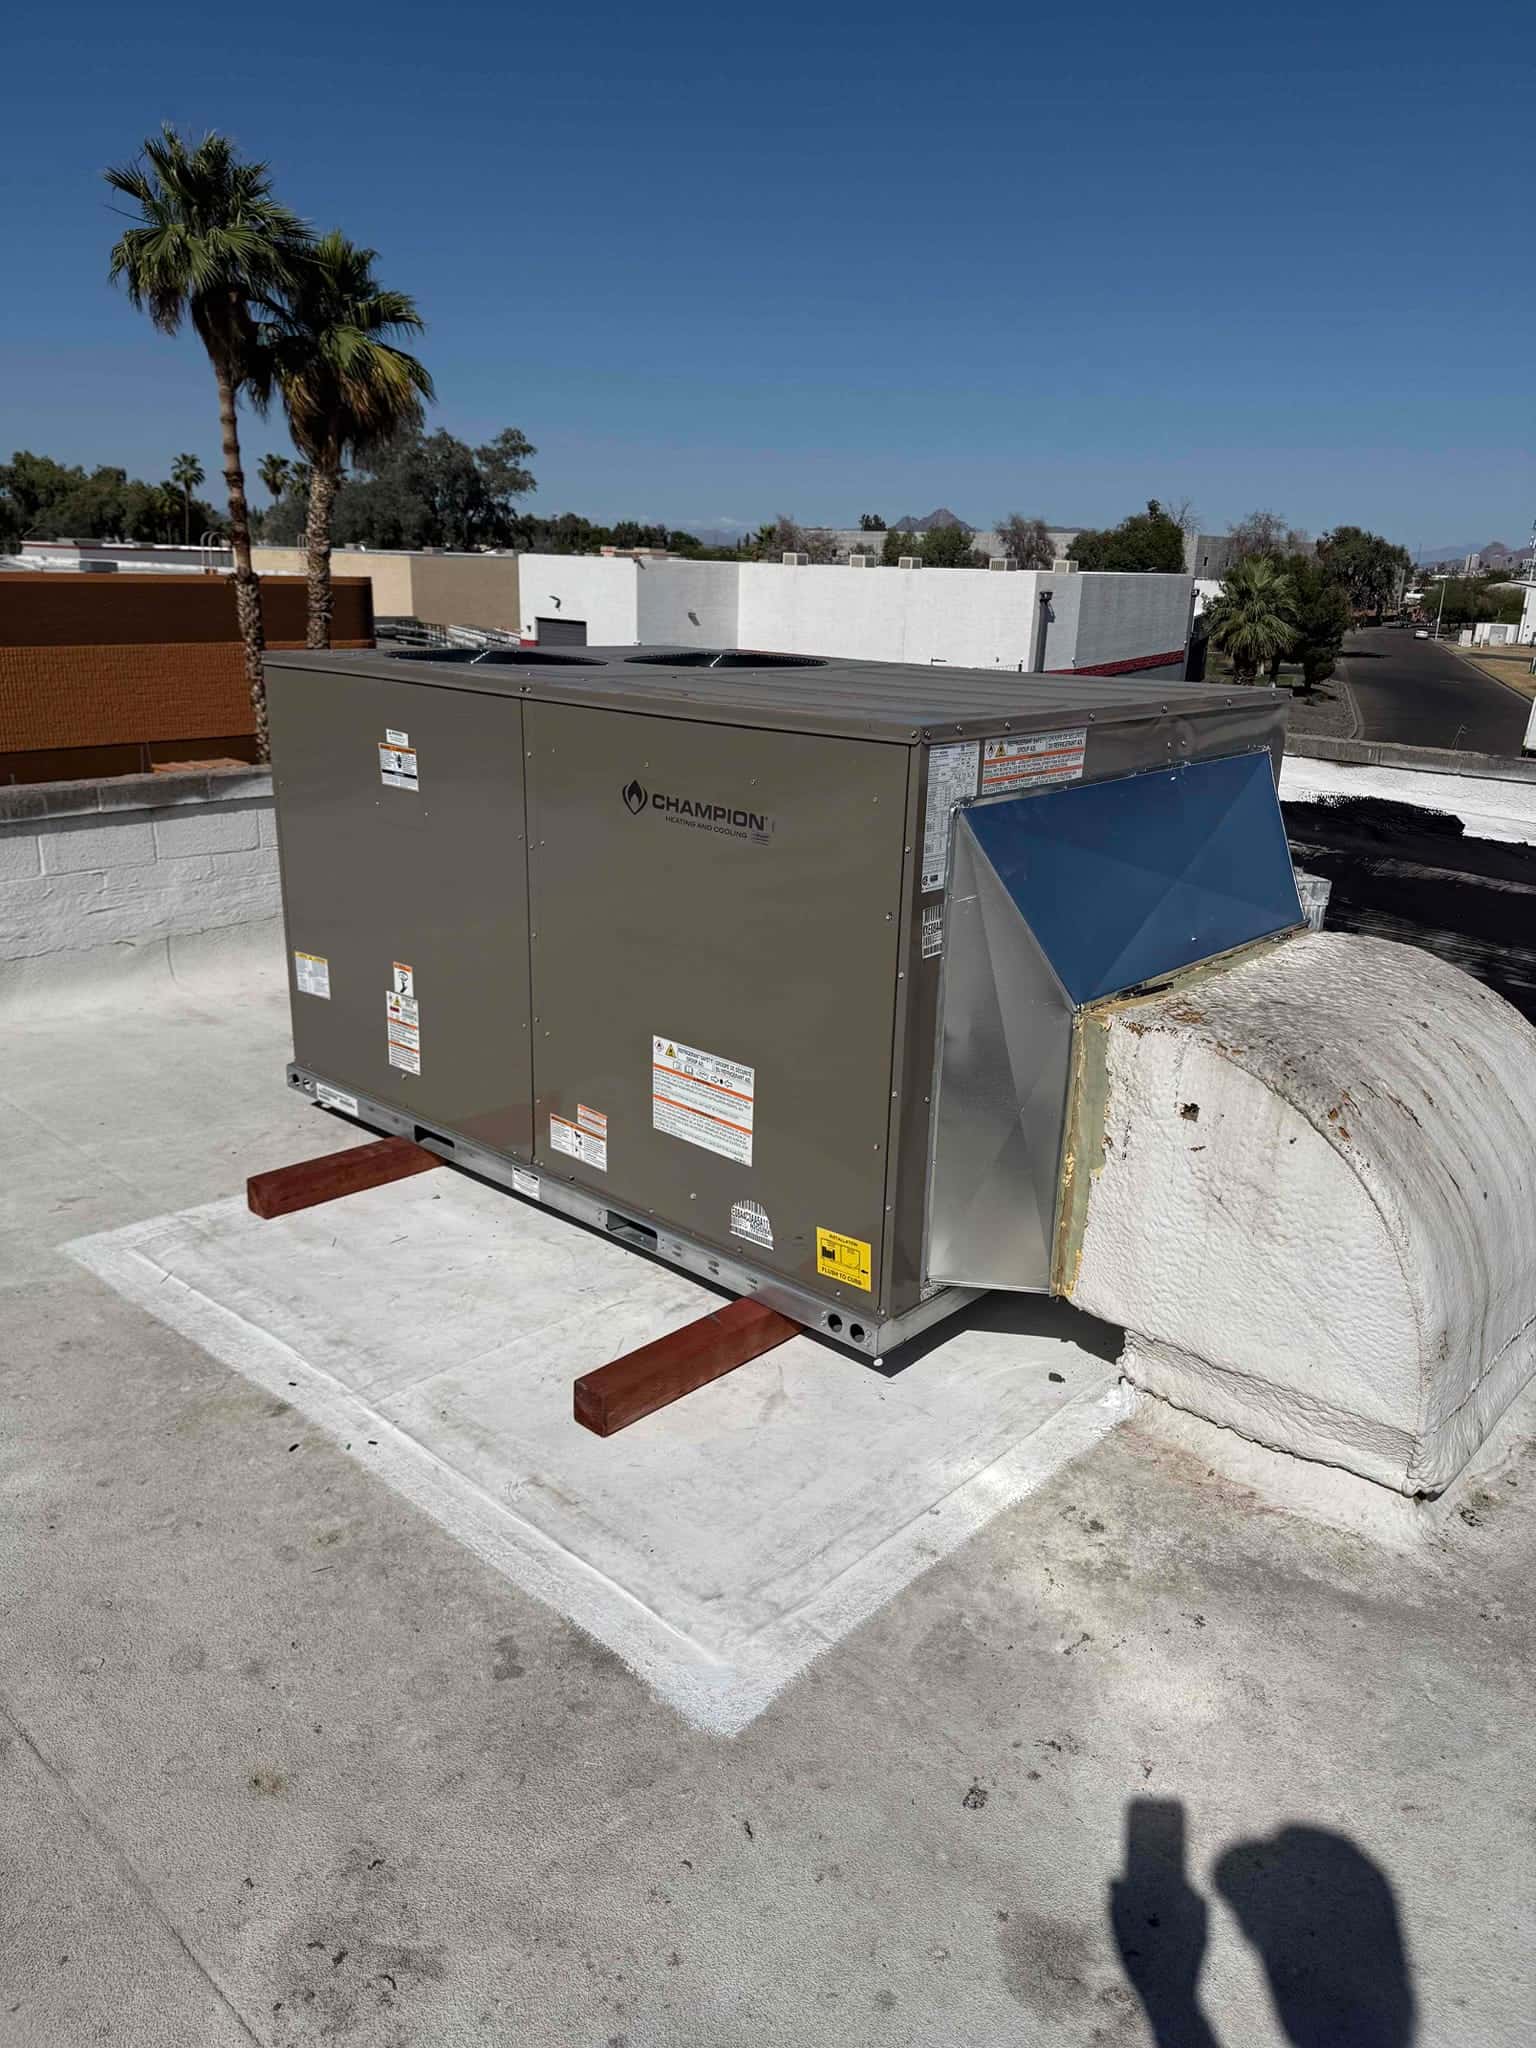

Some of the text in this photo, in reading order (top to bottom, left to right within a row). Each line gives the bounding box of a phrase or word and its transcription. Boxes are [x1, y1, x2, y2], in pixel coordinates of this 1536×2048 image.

[652, 794, 765, 831] CHAMPION
[666, 816, 748, 839] HEATING AND COOLING
